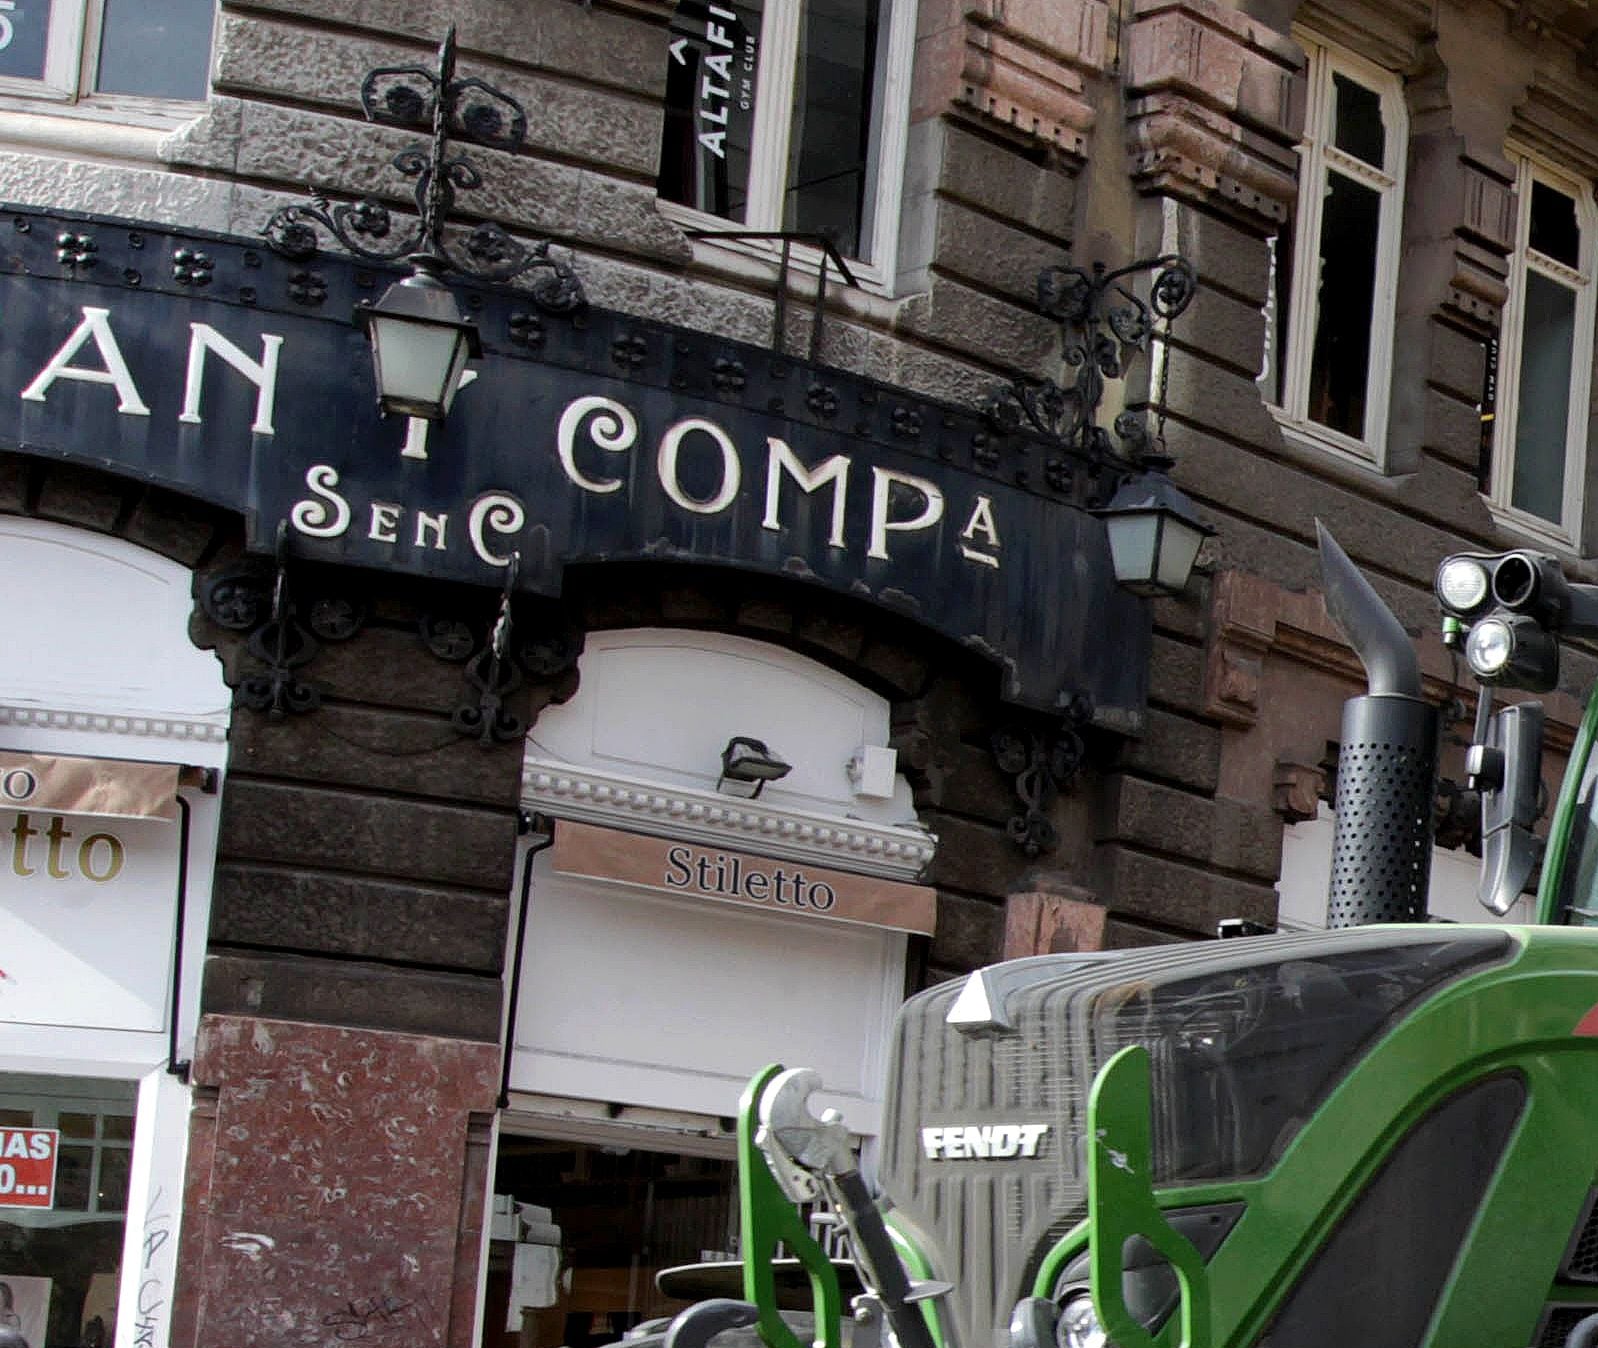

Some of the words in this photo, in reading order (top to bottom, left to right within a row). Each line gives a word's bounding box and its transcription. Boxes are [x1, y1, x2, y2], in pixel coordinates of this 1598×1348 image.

[744, 36, 756, 71] CLUB
[698, 5, 737, 159] ALTAFI
[740, 79, 751, 110] GYM
[12, 813, 125, 883] tto
[665, 847, 835, 911] Stiletto
[0, 1132, 51, 1160] AS
[922, 1124, 1049, 1159] FENDT
